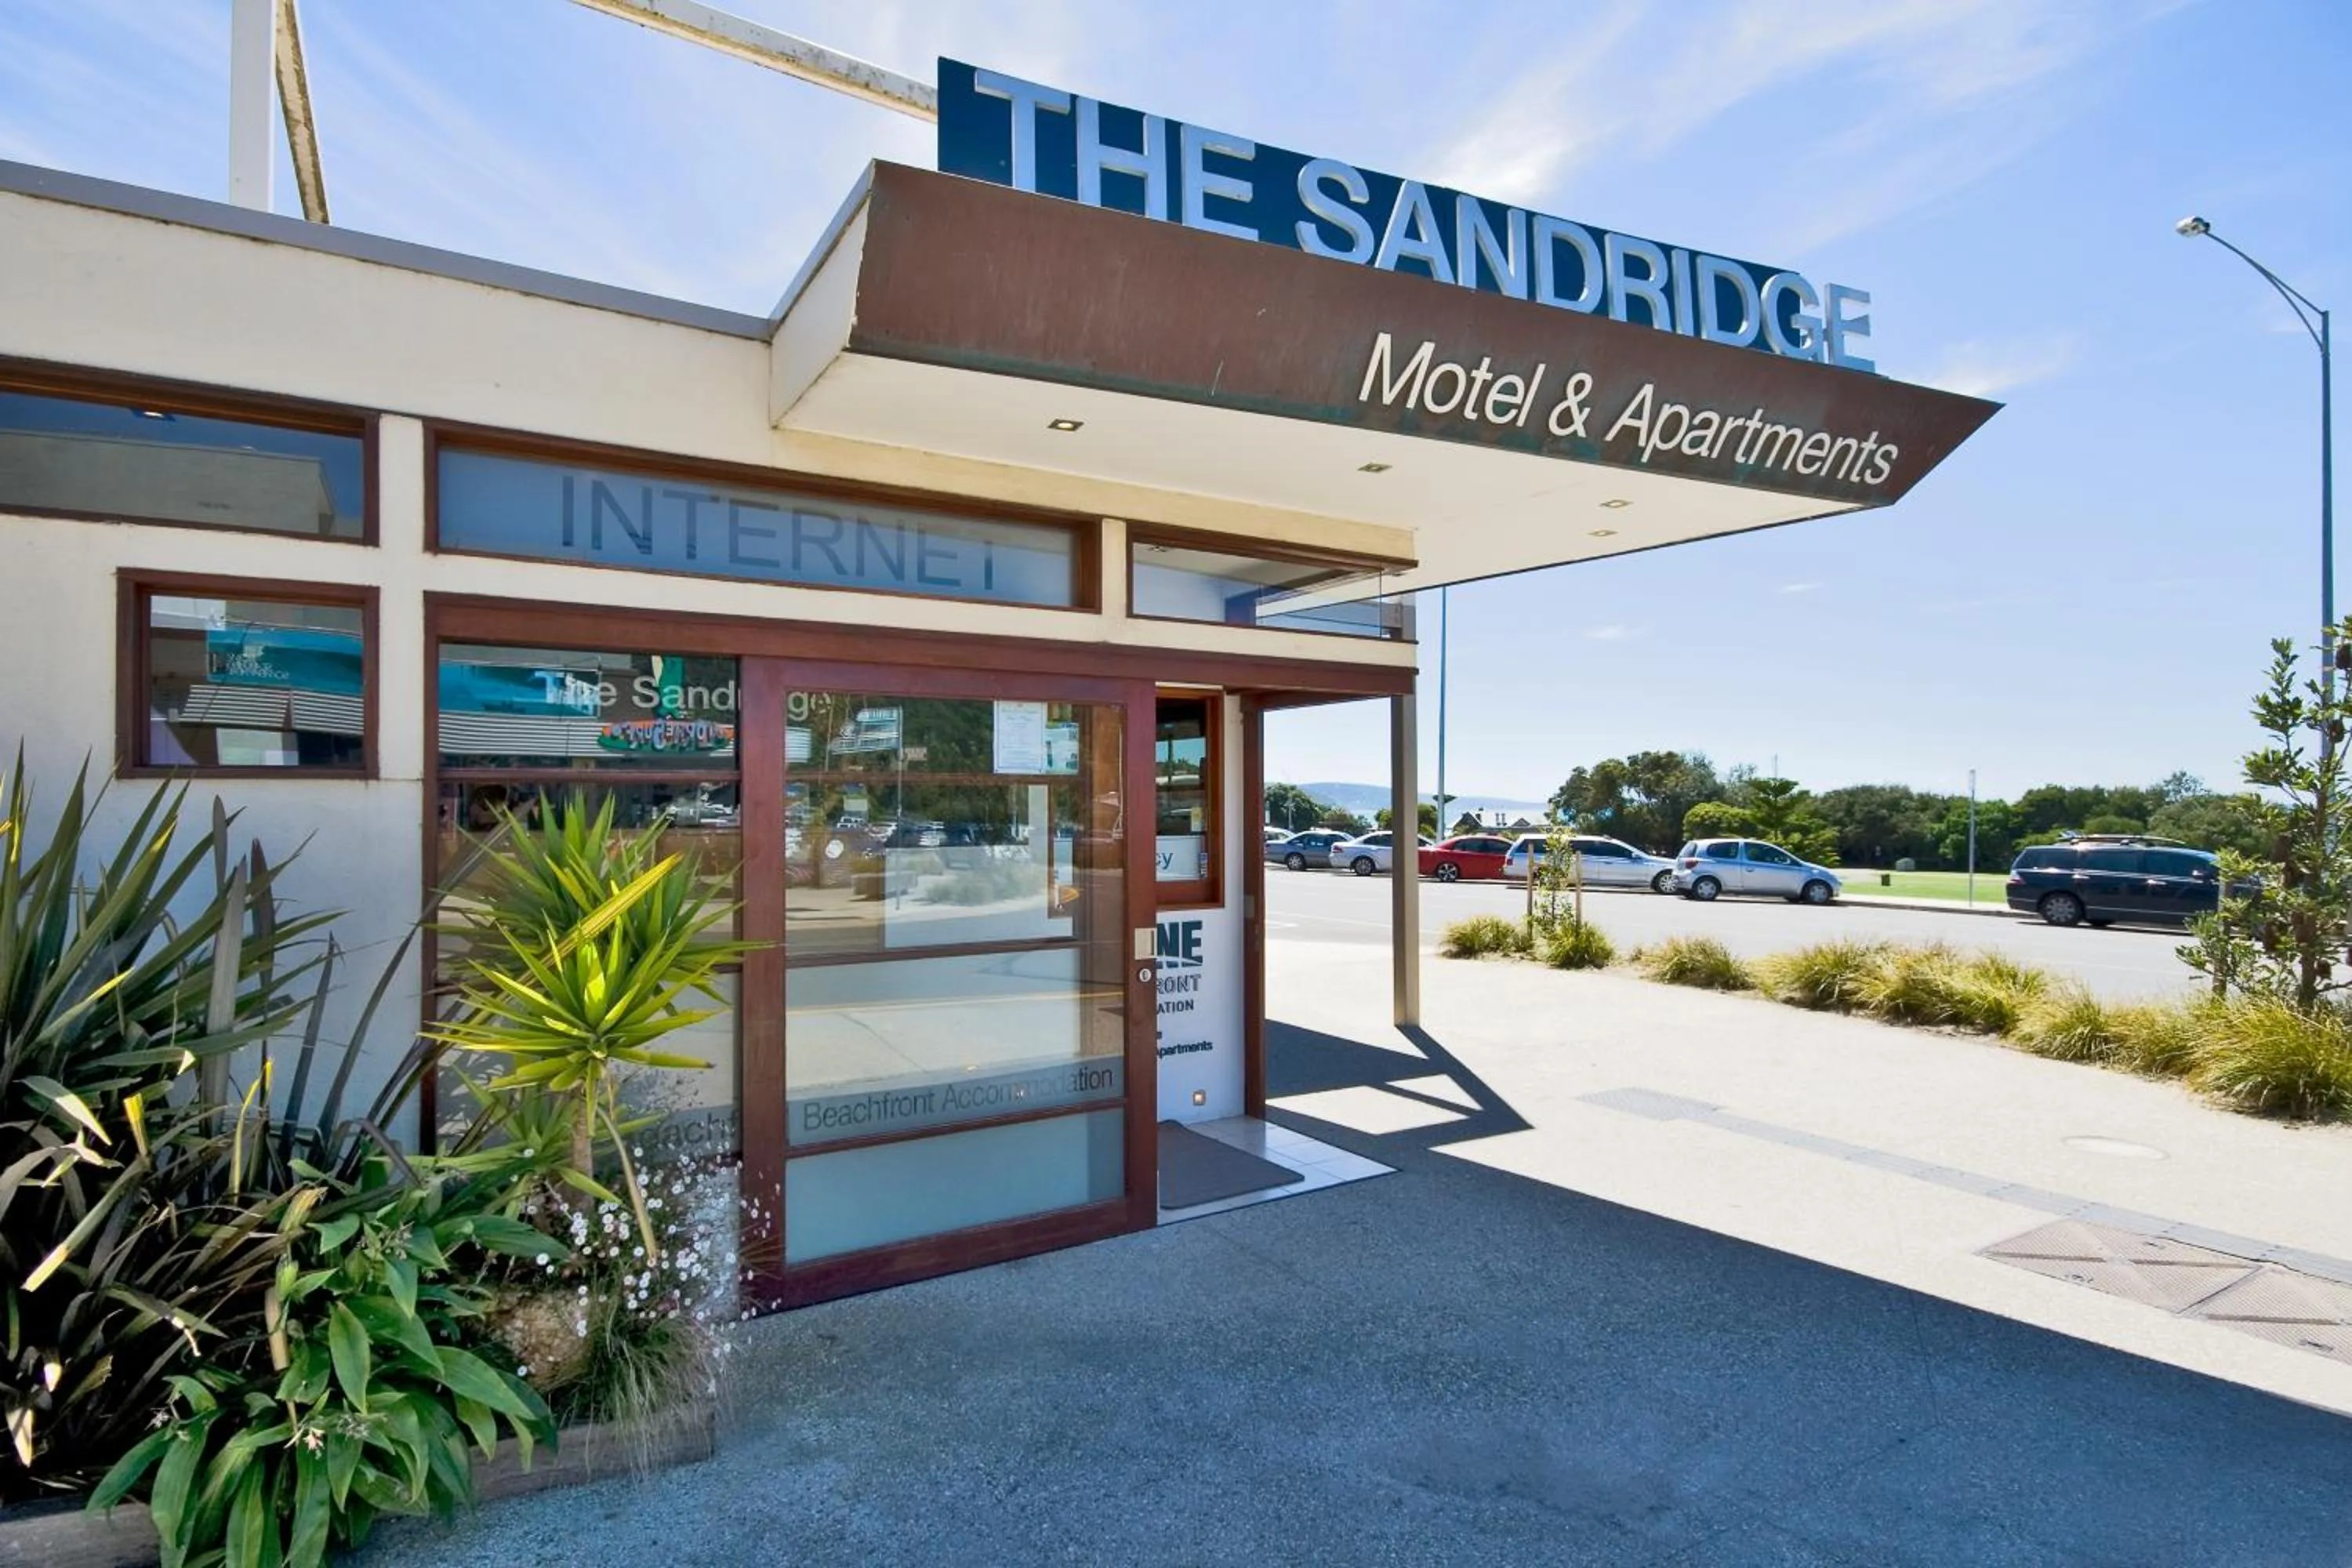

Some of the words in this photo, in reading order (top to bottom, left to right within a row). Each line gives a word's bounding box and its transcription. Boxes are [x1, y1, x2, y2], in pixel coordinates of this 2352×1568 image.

[975, 69, 1259, 241] THE
[1295, 158, 1875, 373] SANDRIDGE
[1359, 332, 1546, 427] Motel
[1548, 372, 1594, 437] &
[1604, 383, 1898, 485] Apartments
[535, 671, 617, 709] The
[1156, 1040, 1213, 1058] partments
[804, 1091, 935, 1131] Beachfront
